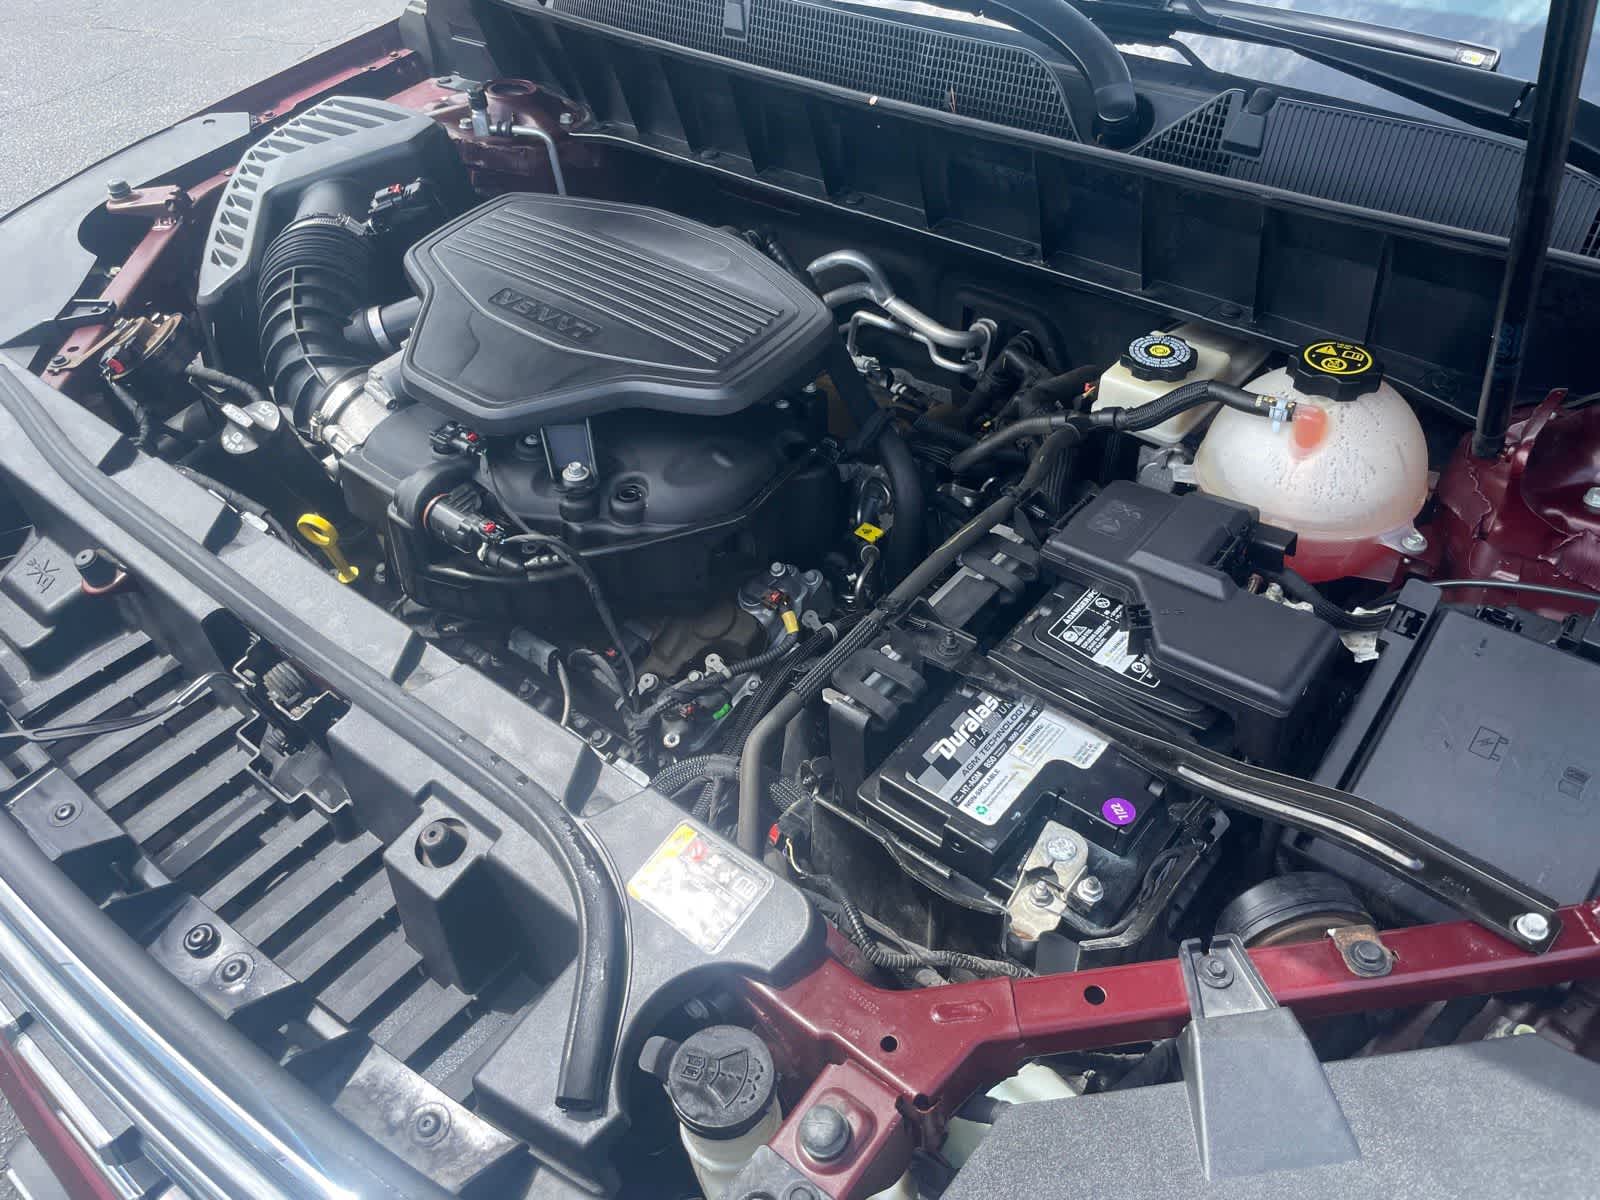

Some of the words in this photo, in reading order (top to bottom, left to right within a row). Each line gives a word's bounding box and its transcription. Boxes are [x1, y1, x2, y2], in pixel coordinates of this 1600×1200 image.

[931, 695, 1001, 760] Duralas
[962, 755, 981, 776] AGM
[979, 703, 1026, 756] TECHNOLOGY
[983, 755, 998, 769] 850
